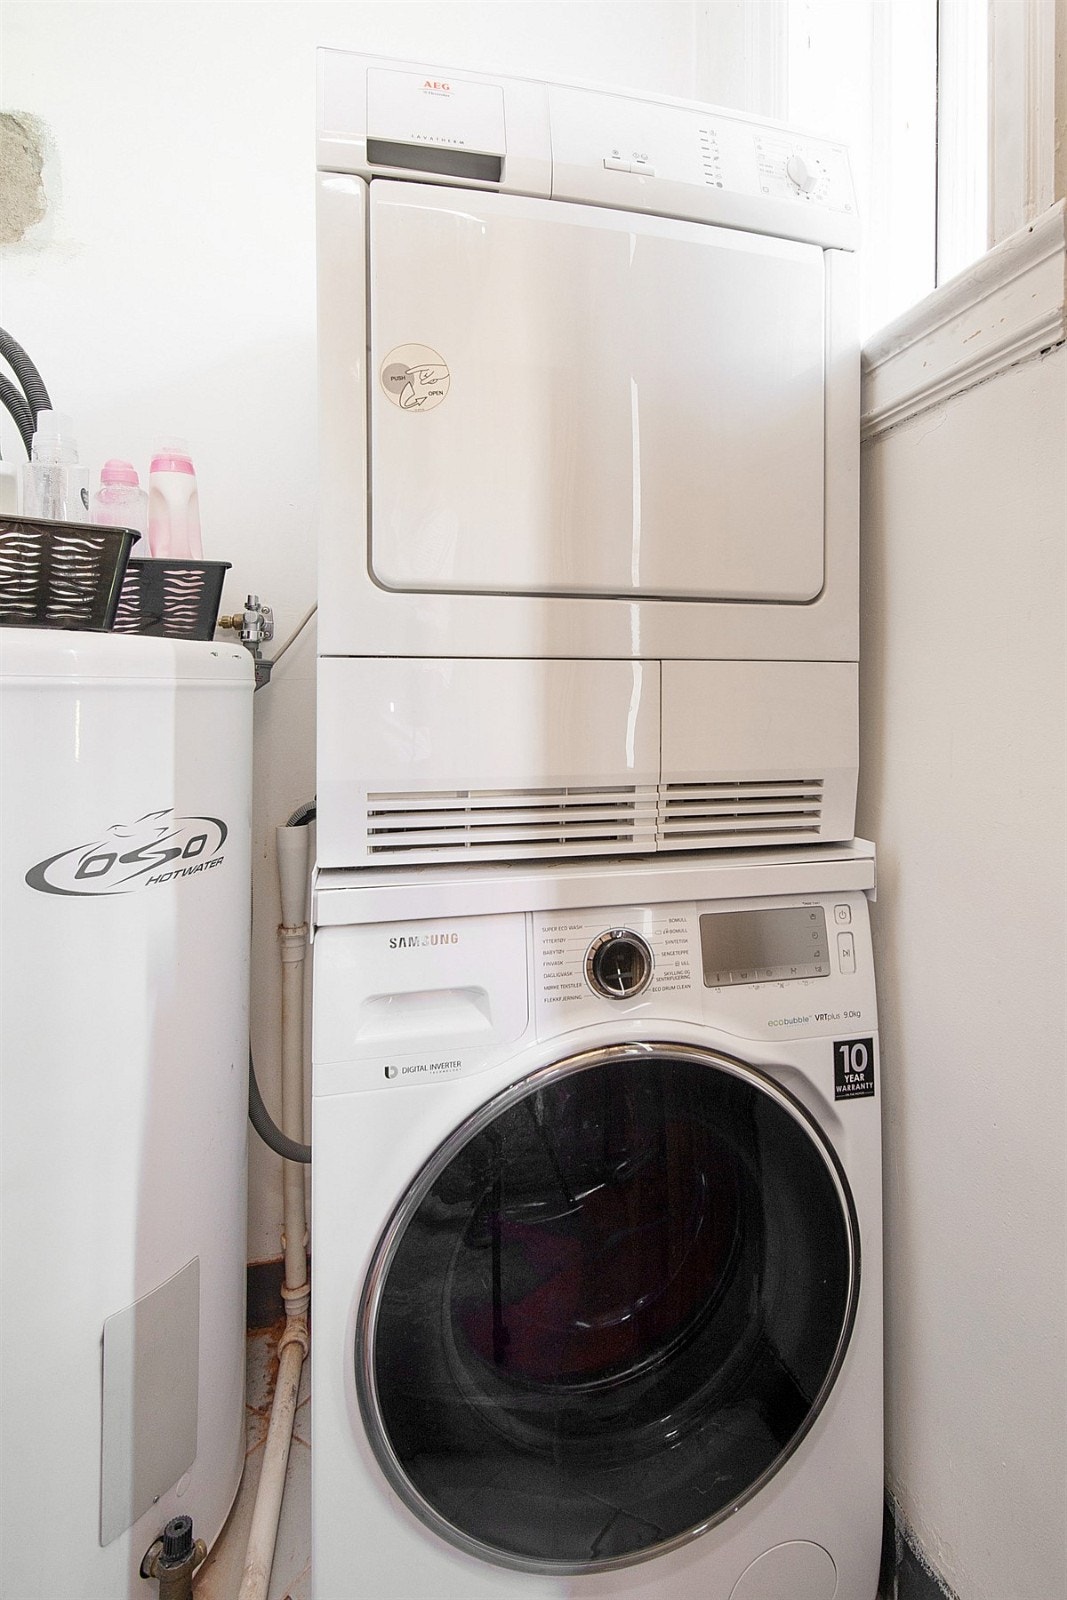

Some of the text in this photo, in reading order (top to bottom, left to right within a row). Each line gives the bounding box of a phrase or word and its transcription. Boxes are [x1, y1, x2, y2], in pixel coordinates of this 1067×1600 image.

[424, 81, 450, 90] AEG
[411, 134, 464, 145] LAVATHERM
[145, 856, 224, 886] HOTWATER
[389, 933, 459, 949] SAMSUNG
[843, 1010, 861, 1020] 9.0kg
[839, 1043, 868, 1073] 10
[401, 1060, 462, 1075] DIGITAL INVERTER
[844, 1073, 865, 1083] YEAR
[836, 1082, 873, 1093] WARRANTY
